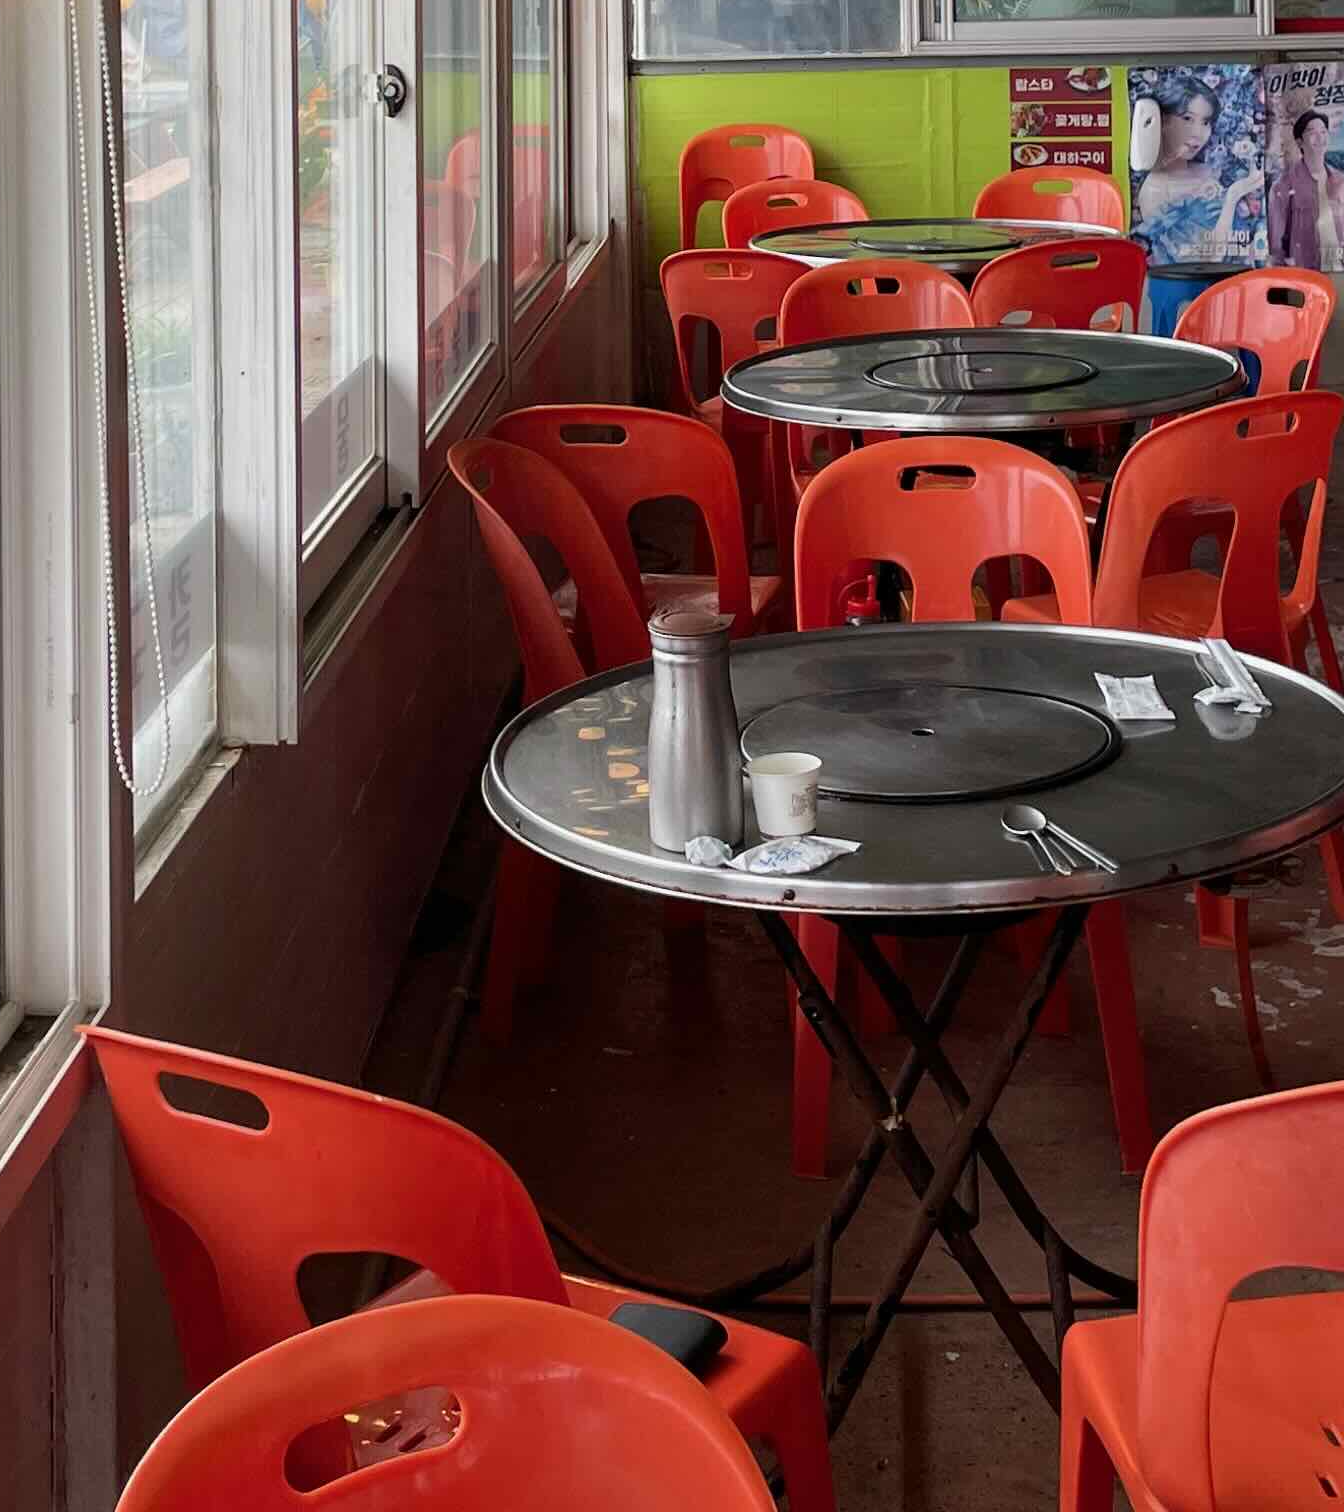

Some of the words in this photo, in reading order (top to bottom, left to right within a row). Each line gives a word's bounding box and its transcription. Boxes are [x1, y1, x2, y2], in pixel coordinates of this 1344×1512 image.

[1269, 73, 1288, 94] 이
[1291, 66, 1327, 89] 맛이
[1053, 151, 1105, 165] 대하구이
